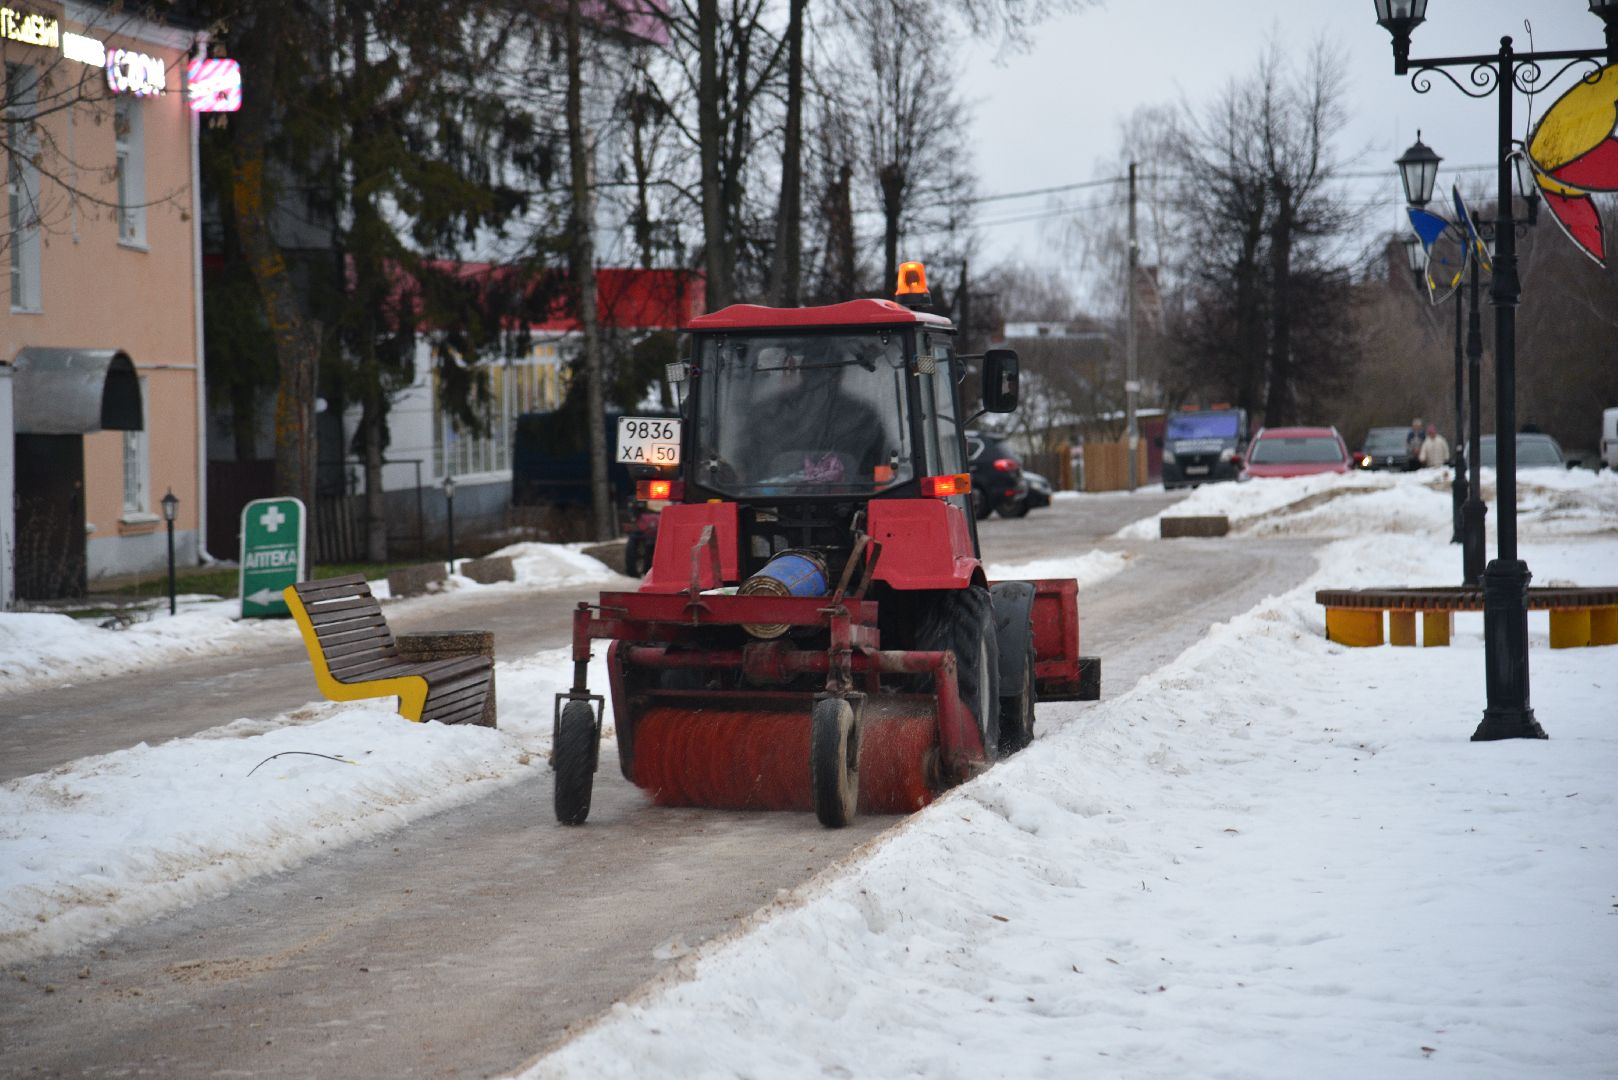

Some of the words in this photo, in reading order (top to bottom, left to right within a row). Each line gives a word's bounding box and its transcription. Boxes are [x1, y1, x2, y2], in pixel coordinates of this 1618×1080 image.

[626, 421, 673, 440] 9836
[656, 447, 676, 461] 50
[246, 549, 297, 568] АПТЕКА
